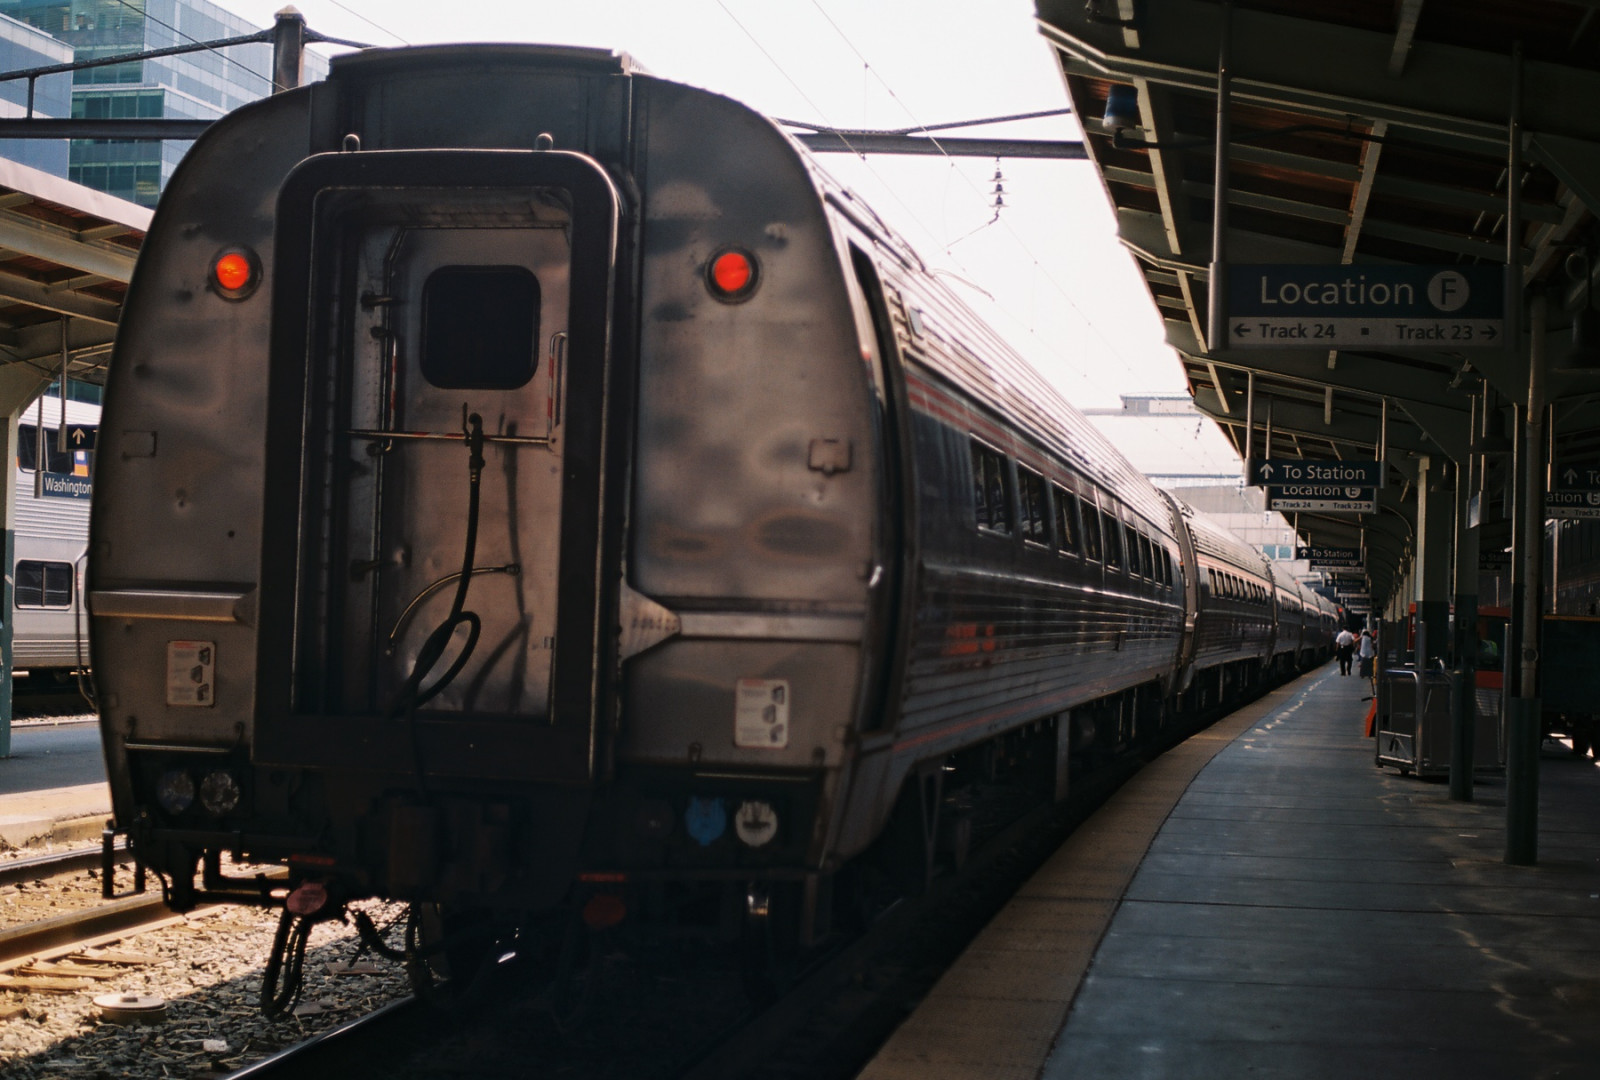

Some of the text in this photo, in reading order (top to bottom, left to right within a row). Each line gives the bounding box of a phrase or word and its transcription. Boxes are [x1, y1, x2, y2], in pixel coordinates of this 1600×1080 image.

[1261, 275, 1457, 306] Location F
[1259, 323, 1473, 341] Track 24 Track 23
[1282, 465, 1366, 480] To Station
[45, 478, 92, 497] Washington
[1282, 486, 1341, 496] Location
[1546, 492, 1582, 503] ation
[1282, 501, 1300, 509] Track
[1333, 502, 1351, 510] Track
[1312, 549, 1354, 558] To Station
